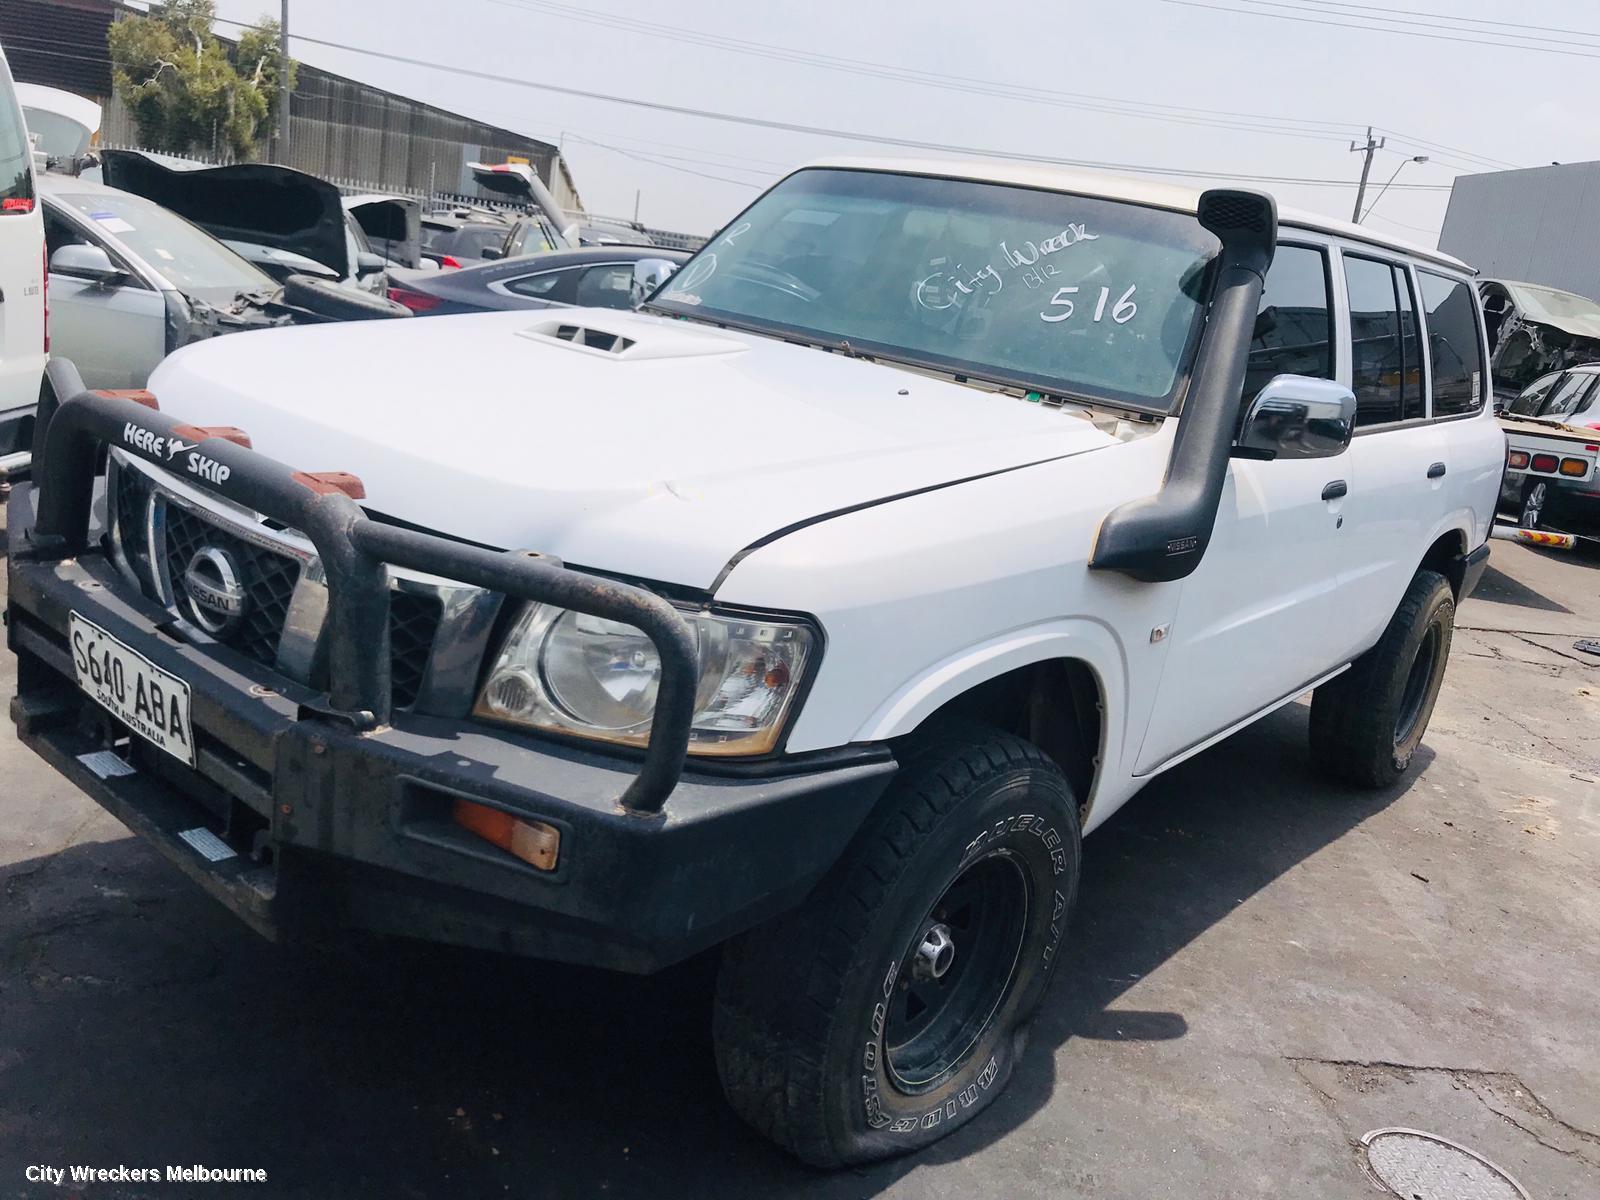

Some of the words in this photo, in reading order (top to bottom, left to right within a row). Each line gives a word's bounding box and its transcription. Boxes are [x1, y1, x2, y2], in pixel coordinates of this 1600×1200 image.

[123, 422, 164, 458] HERE
[187, 452, 231, 485] SKIP
[96, 688, 120, 715] SOUTH
[121, 709, 166, 747] AUSTRALIA
[862, 961, 998, 1132] BRIDGESTONE
